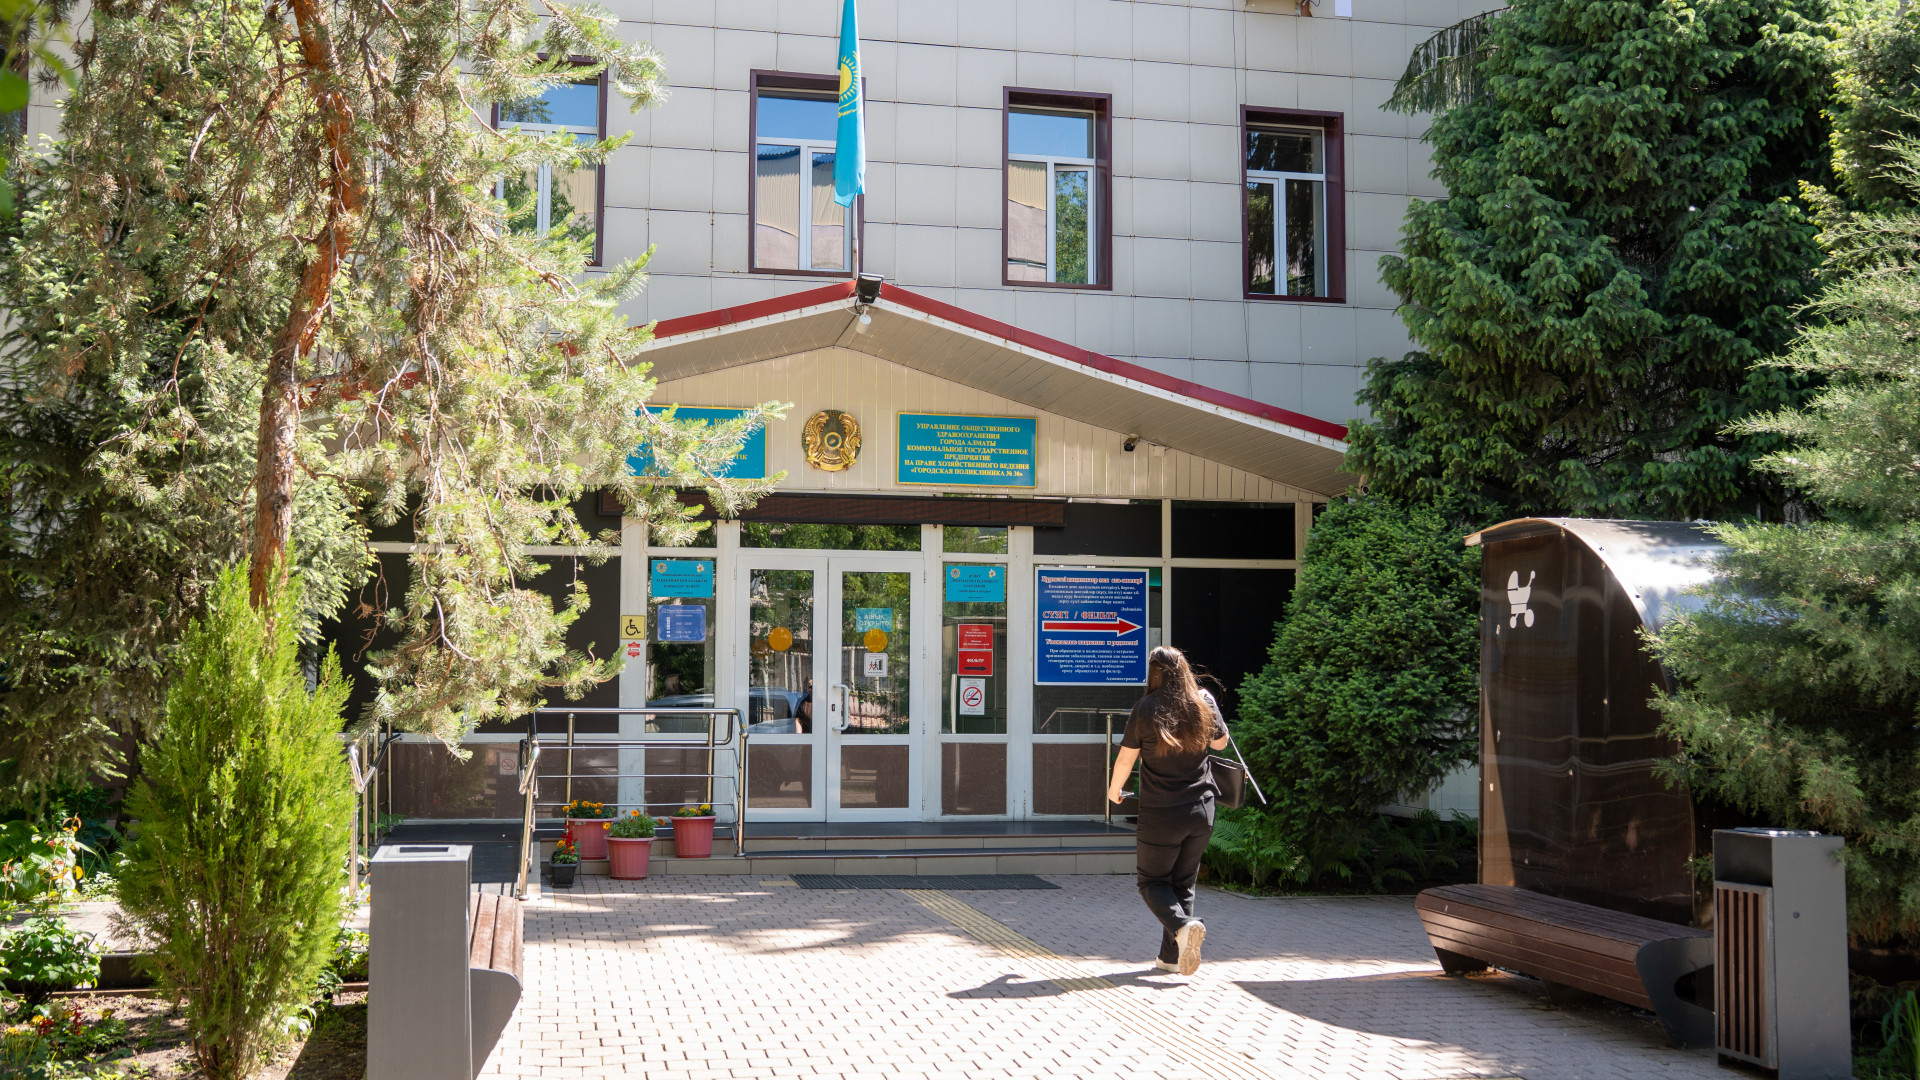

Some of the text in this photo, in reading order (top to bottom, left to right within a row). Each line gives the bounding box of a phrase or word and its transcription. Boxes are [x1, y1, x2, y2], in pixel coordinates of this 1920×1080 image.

[916, 423, 1020, 433] УПРАВЛЕНИЕ ОБЩЕСТВЕННОГО
[937, 431, 1000, 439] ЗДРАВООХРАНЕНИЯ
[906, 445, 1028, 455] КОММУНАЛЬНОЕ ГОСУДАРСТВЕННОЕ
[938, 460, 998, 469] ХОЗЯЙСТВЕННОГО
[911, 467, 953, 475] «ГОРОДСКАЯ
[954, 468, 1005, 477] ПОЛИКЛИНИКА
[1042, 611, 1069, 619] СҮЗГІ
